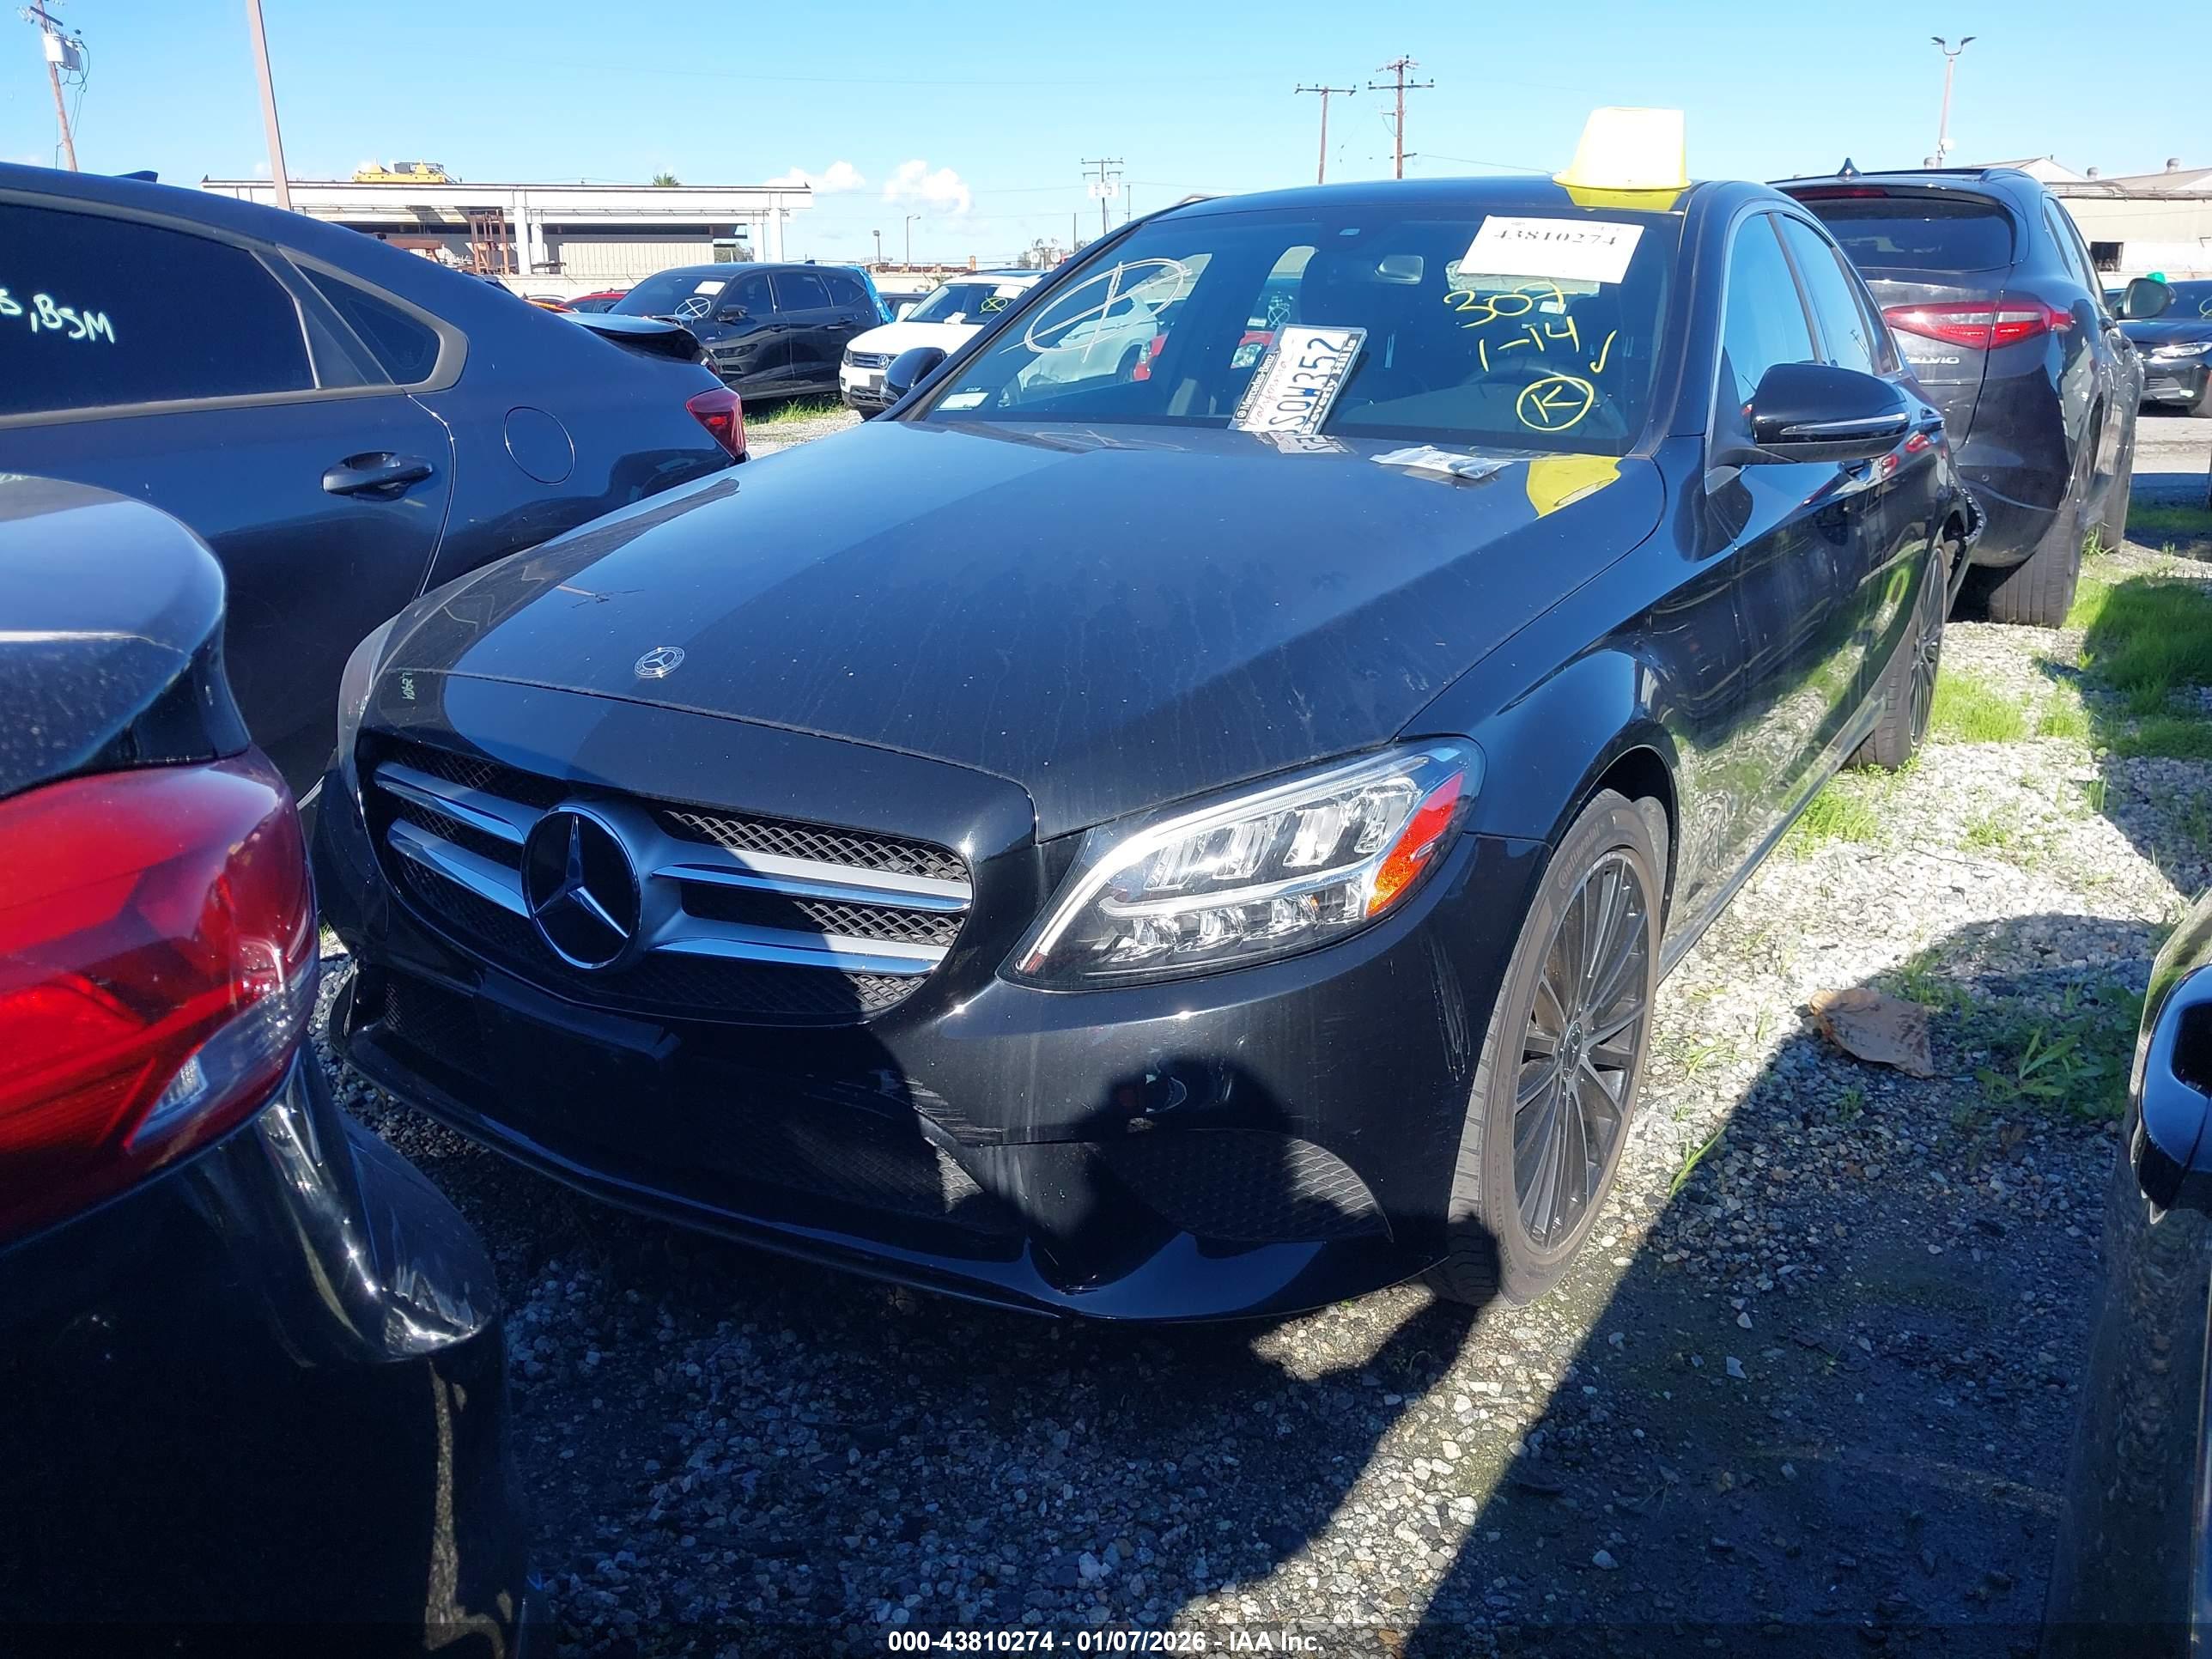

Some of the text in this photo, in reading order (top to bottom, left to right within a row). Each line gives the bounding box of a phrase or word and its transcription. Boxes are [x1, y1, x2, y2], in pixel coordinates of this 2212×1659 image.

[1493, 229, 1617, 246] 43810274
[1242, 353, 1276, 410] Mercedes-Benz
[1245, 360, 1287, 426] California
[1303, 377, 1339, 434] Beverly
[1335, 337, 1358, 374] Hills
[1558, 822, 1601, 890] Continental
